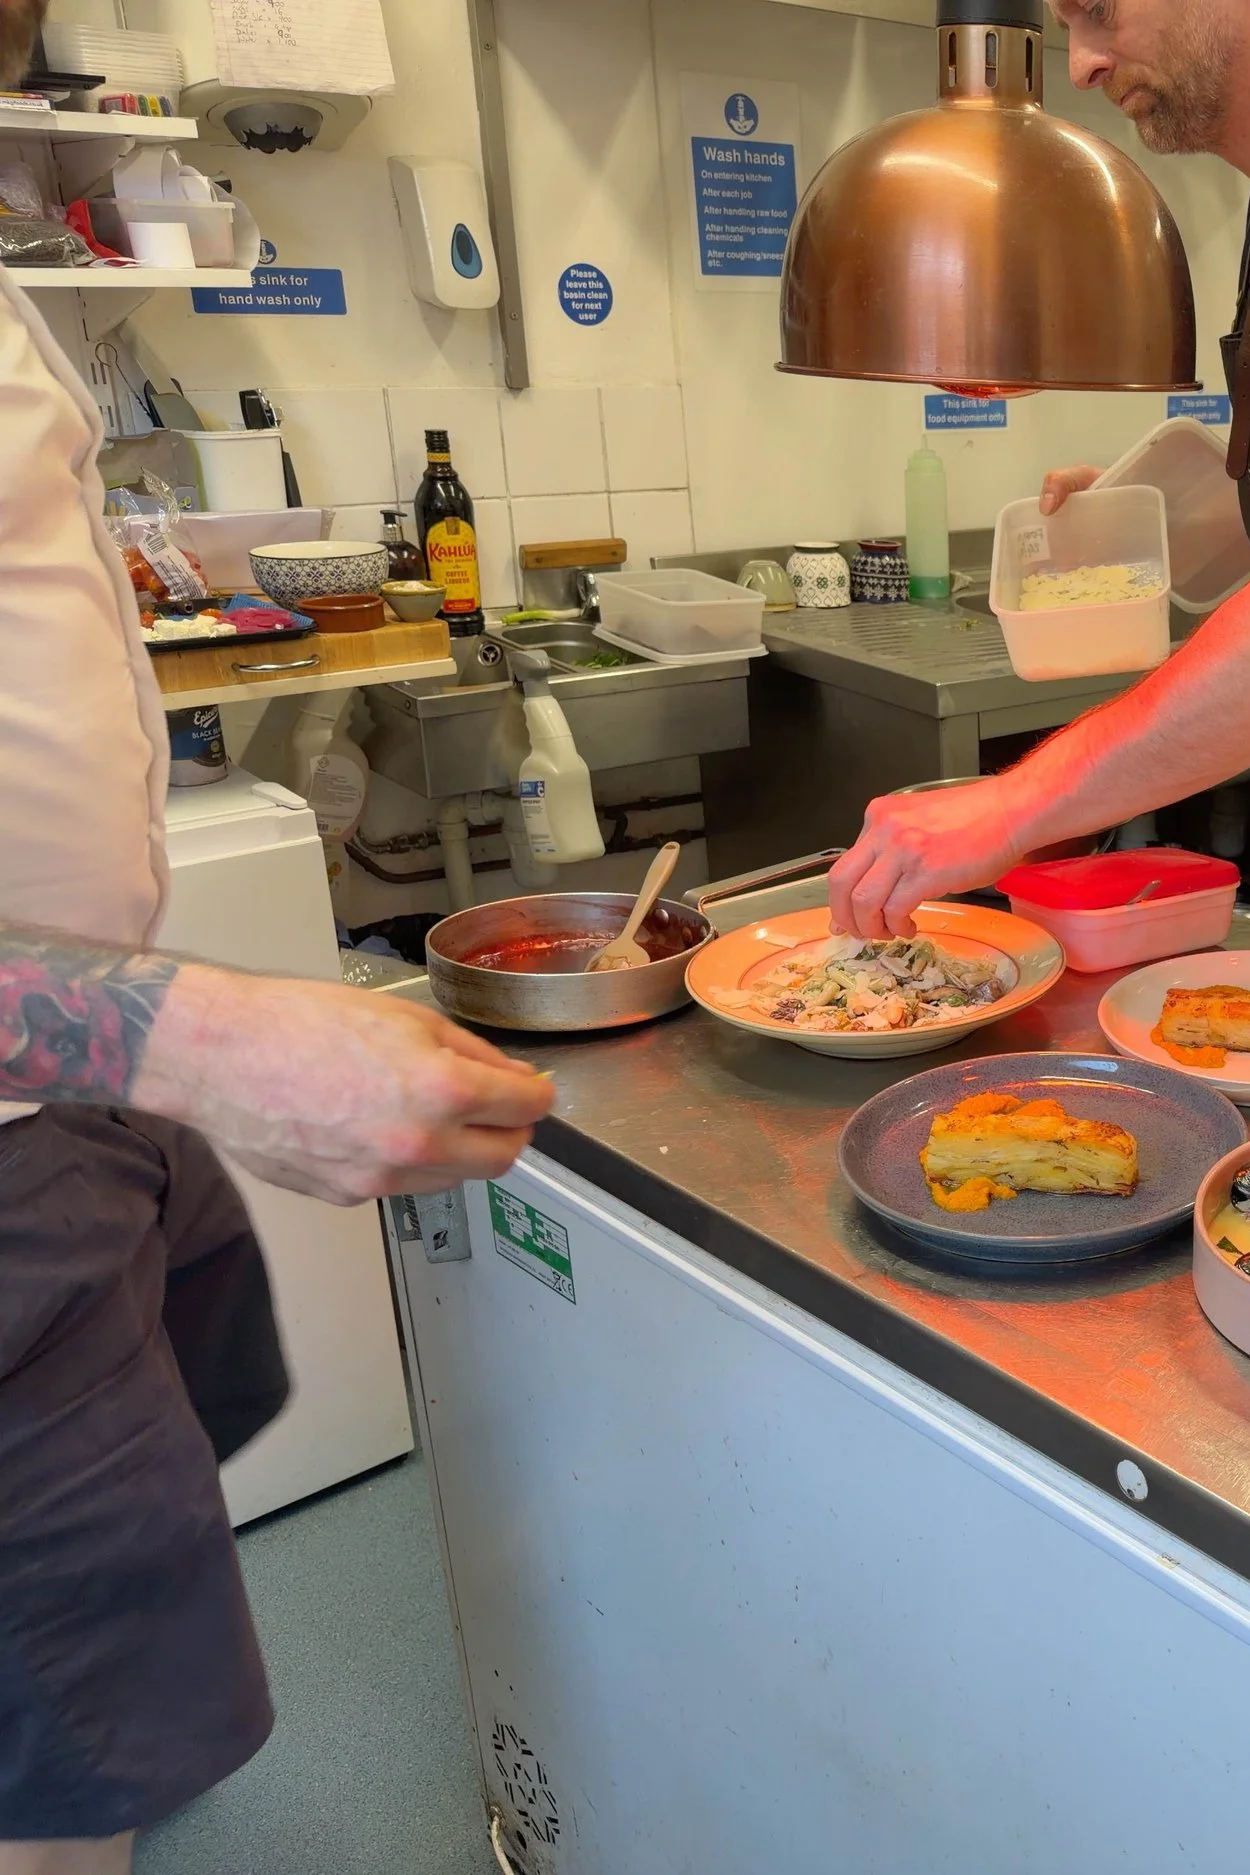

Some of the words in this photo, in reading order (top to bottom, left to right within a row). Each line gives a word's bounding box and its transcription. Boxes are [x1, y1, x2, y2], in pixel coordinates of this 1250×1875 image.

[703, 146, 741, 162] Wash
[745, 150, 786, 166] hands
[701, 169, 712, 179] On
[714, 171, 744, 182] entering
[745, 173, 772, 182] kitchen
[702, 188, 720, 197] After
[722, 189, 740, 198] each
[740, 190, 752, 200] job
[704, 206, 722, 215] After
[723, 207, 756, 218] handling
[771, 209, 788, 218] food
[705, 224, 723, 232] After
[757, 226, 788, 237] cleaning
[706, 233, 744, 242] chemicals
[707, 249, 725, 258] After
[708, 259, 723, 268] etc.
[571, 269, 597, 278] Please
[260, 274, 287, 286] sink
[290, 274, 308, 286] for
[566, 280, 587, 288] leave
[219, 293, 253, 305] hand
[256, 294, 290, 306] wash
[294, 295, 321, 308] only
[587, 292, 608, 300] clean
[943, 399, 960, 408] This
[961, 400, 978, 408] sink
[978, 400, 990, 408] for
[928, 414, 946, 423] food
[947, 414, 987, 424] equipment
[988, 413, 1004, 424] only
[429, 541, 476, 562] KAHLÚA
[192, 730, 213, 739] BLACK
